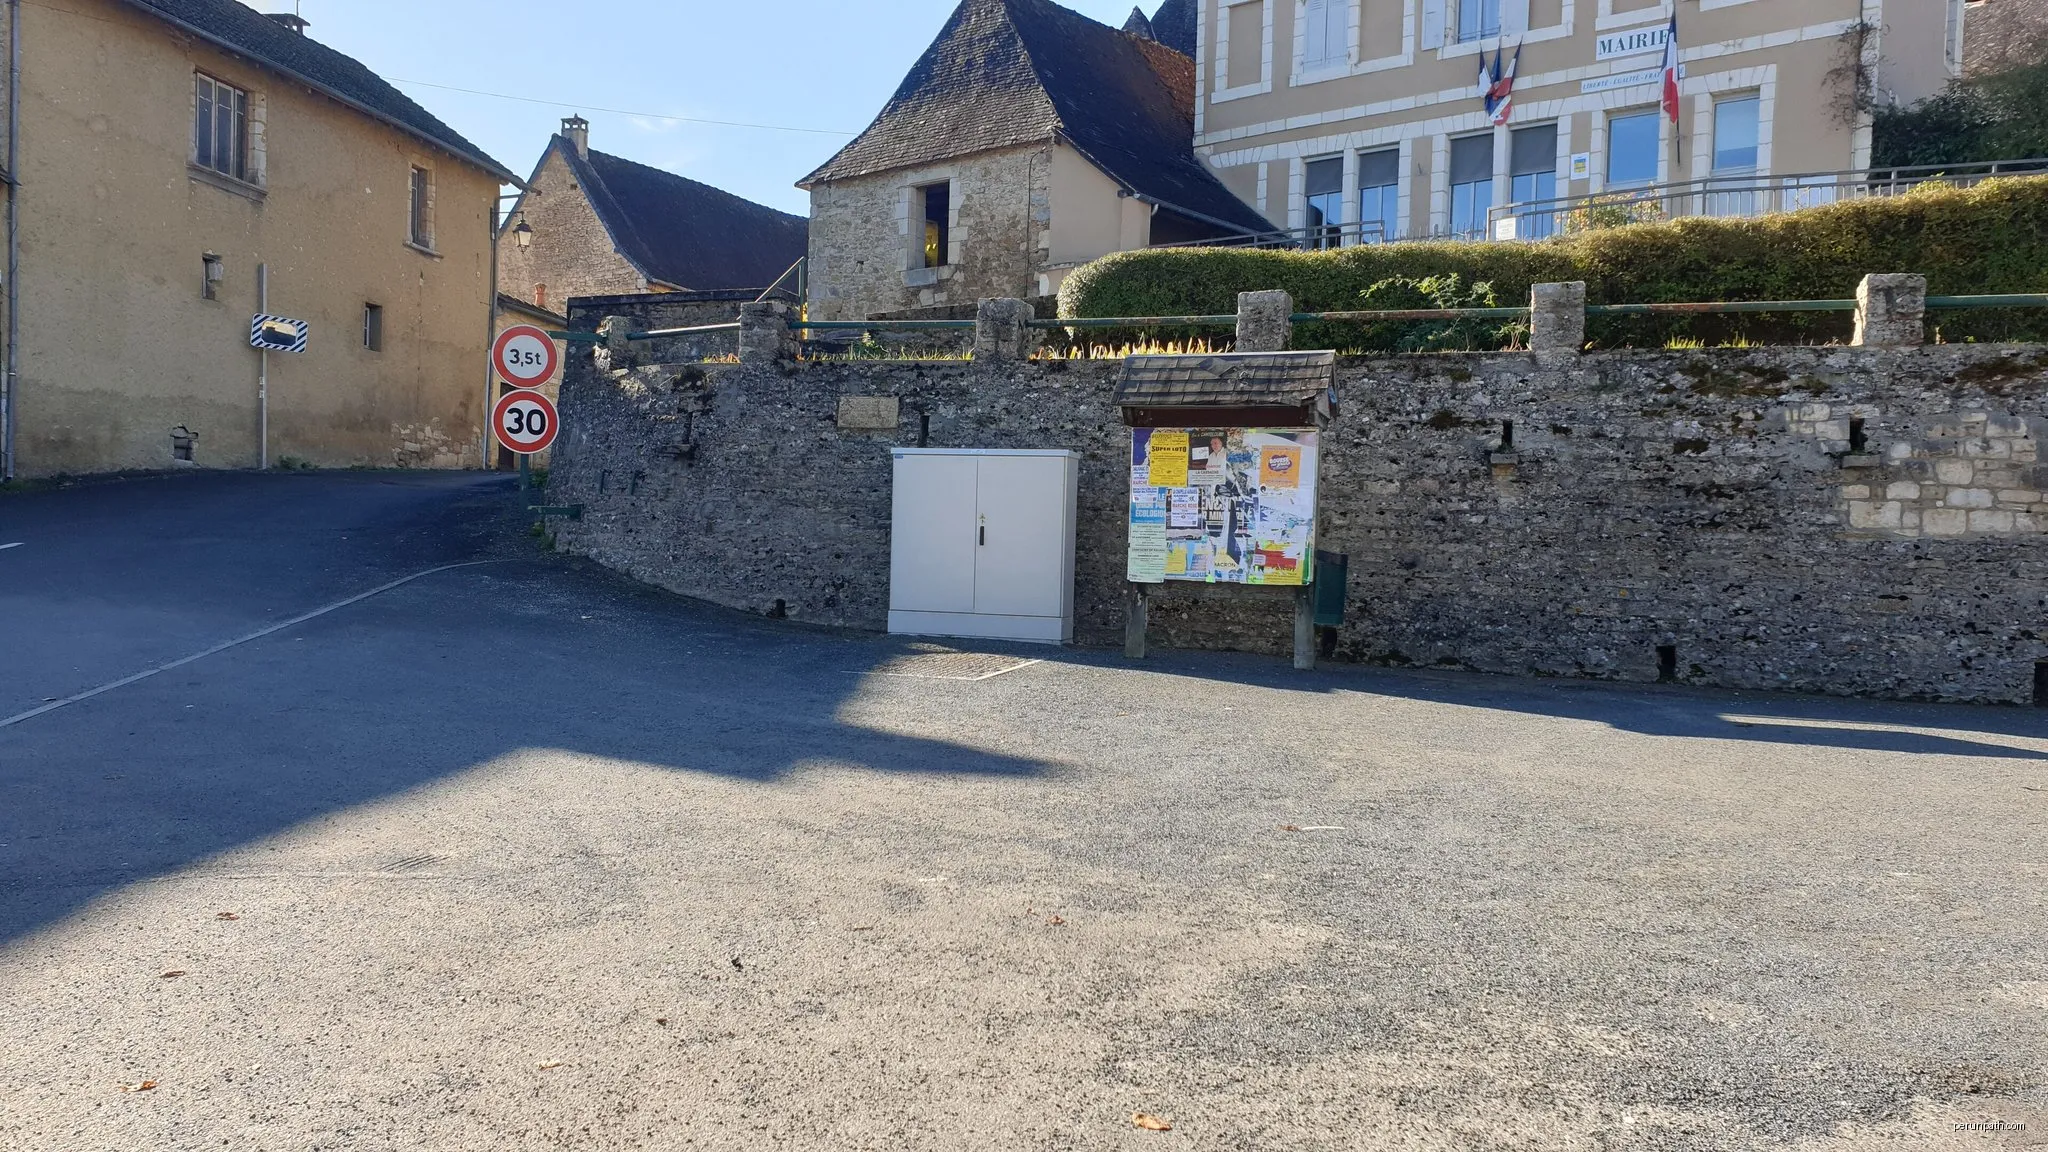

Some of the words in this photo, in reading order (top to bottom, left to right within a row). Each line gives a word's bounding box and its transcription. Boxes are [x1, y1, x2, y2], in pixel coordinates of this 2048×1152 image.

[1599, 29, 1668, 55] MAIRIE
[509, 348, 542, 367] 3,5t
[506, 407, 546, 435] 30
